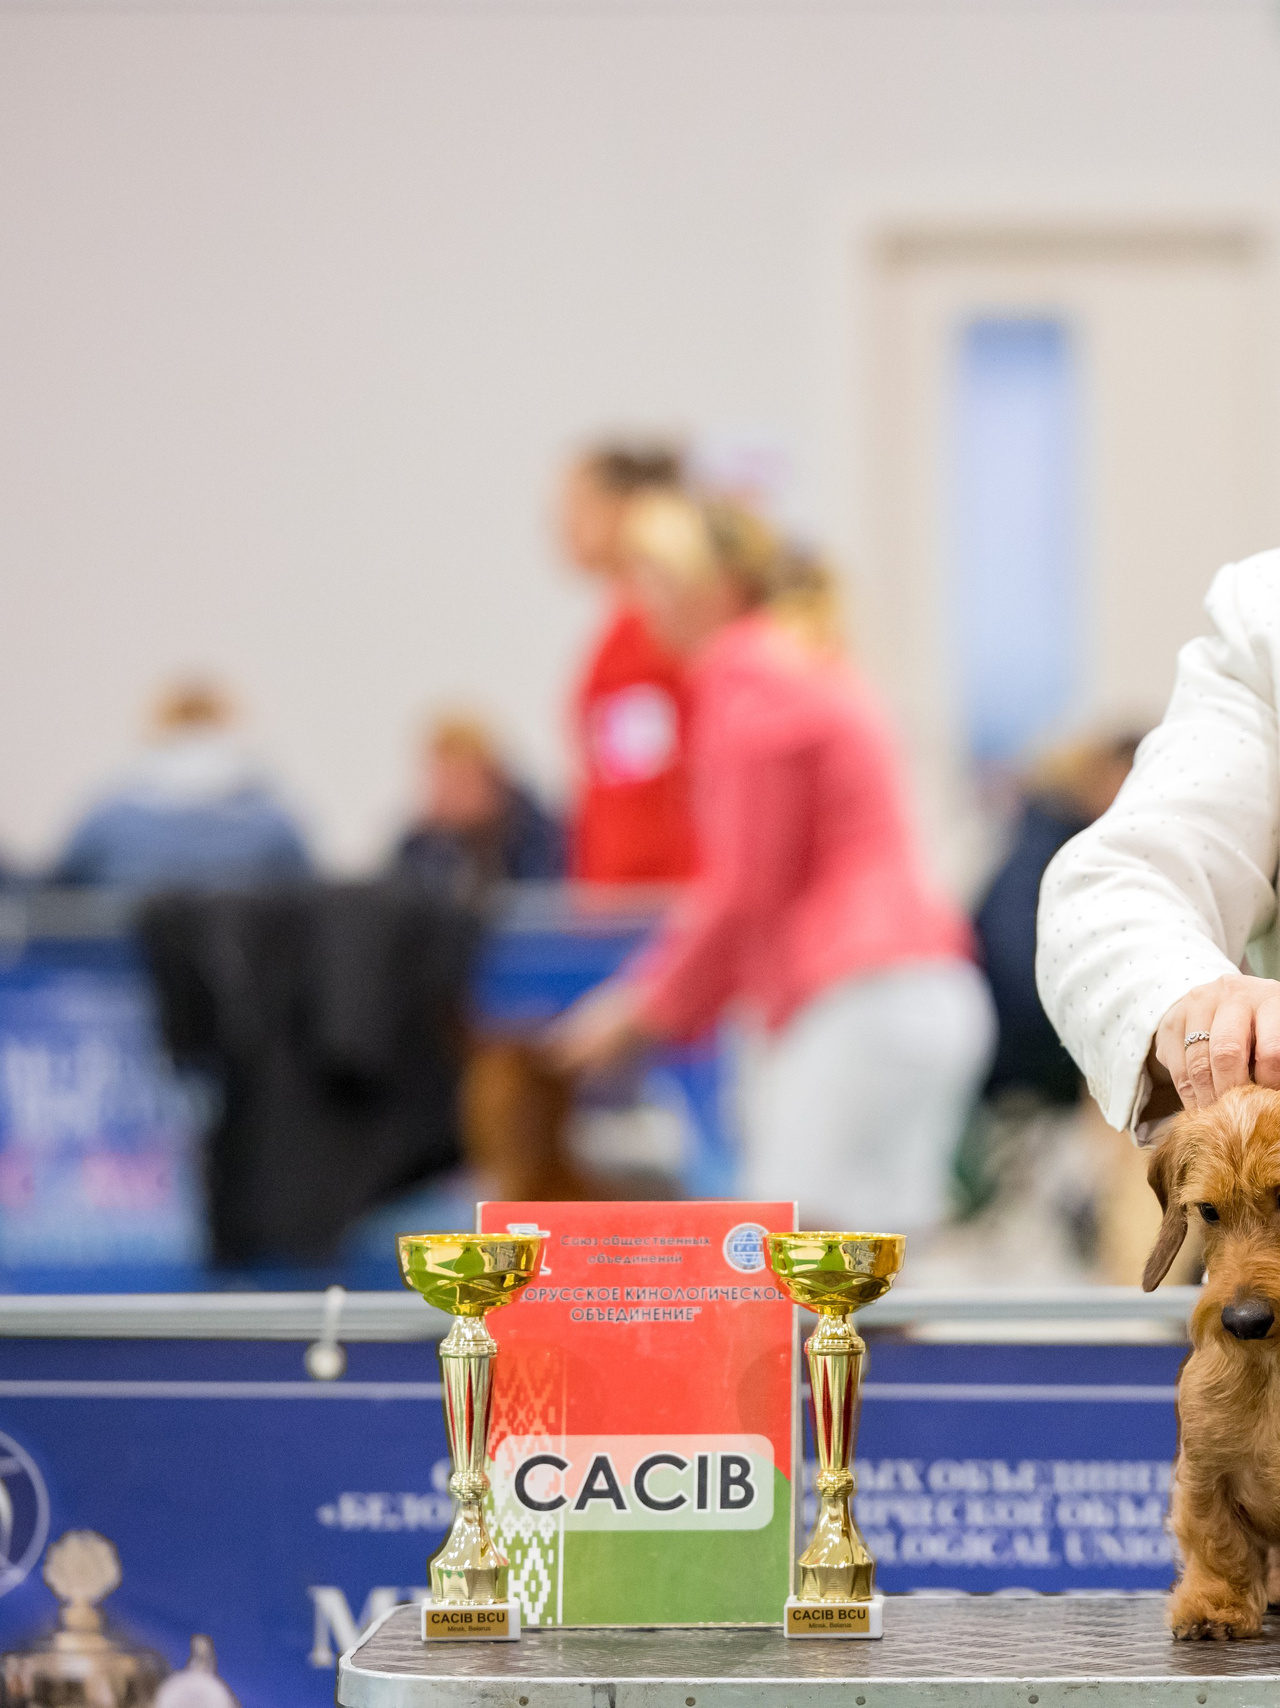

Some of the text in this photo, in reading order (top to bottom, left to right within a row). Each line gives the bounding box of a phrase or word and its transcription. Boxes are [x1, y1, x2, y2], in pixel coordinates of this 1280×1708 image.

[560, 1234, 711, 1246] Союз общественных
[587, 1252, 683, 1264] объединений
[521, 1287, 621, 1301] ОРУССКОЕ
[513, 1453, 756, 1512] CACIB
[431, 1612, 505, 1624] CACIB BCU
[791, 1609, 866, 1620] CACIB BCU
